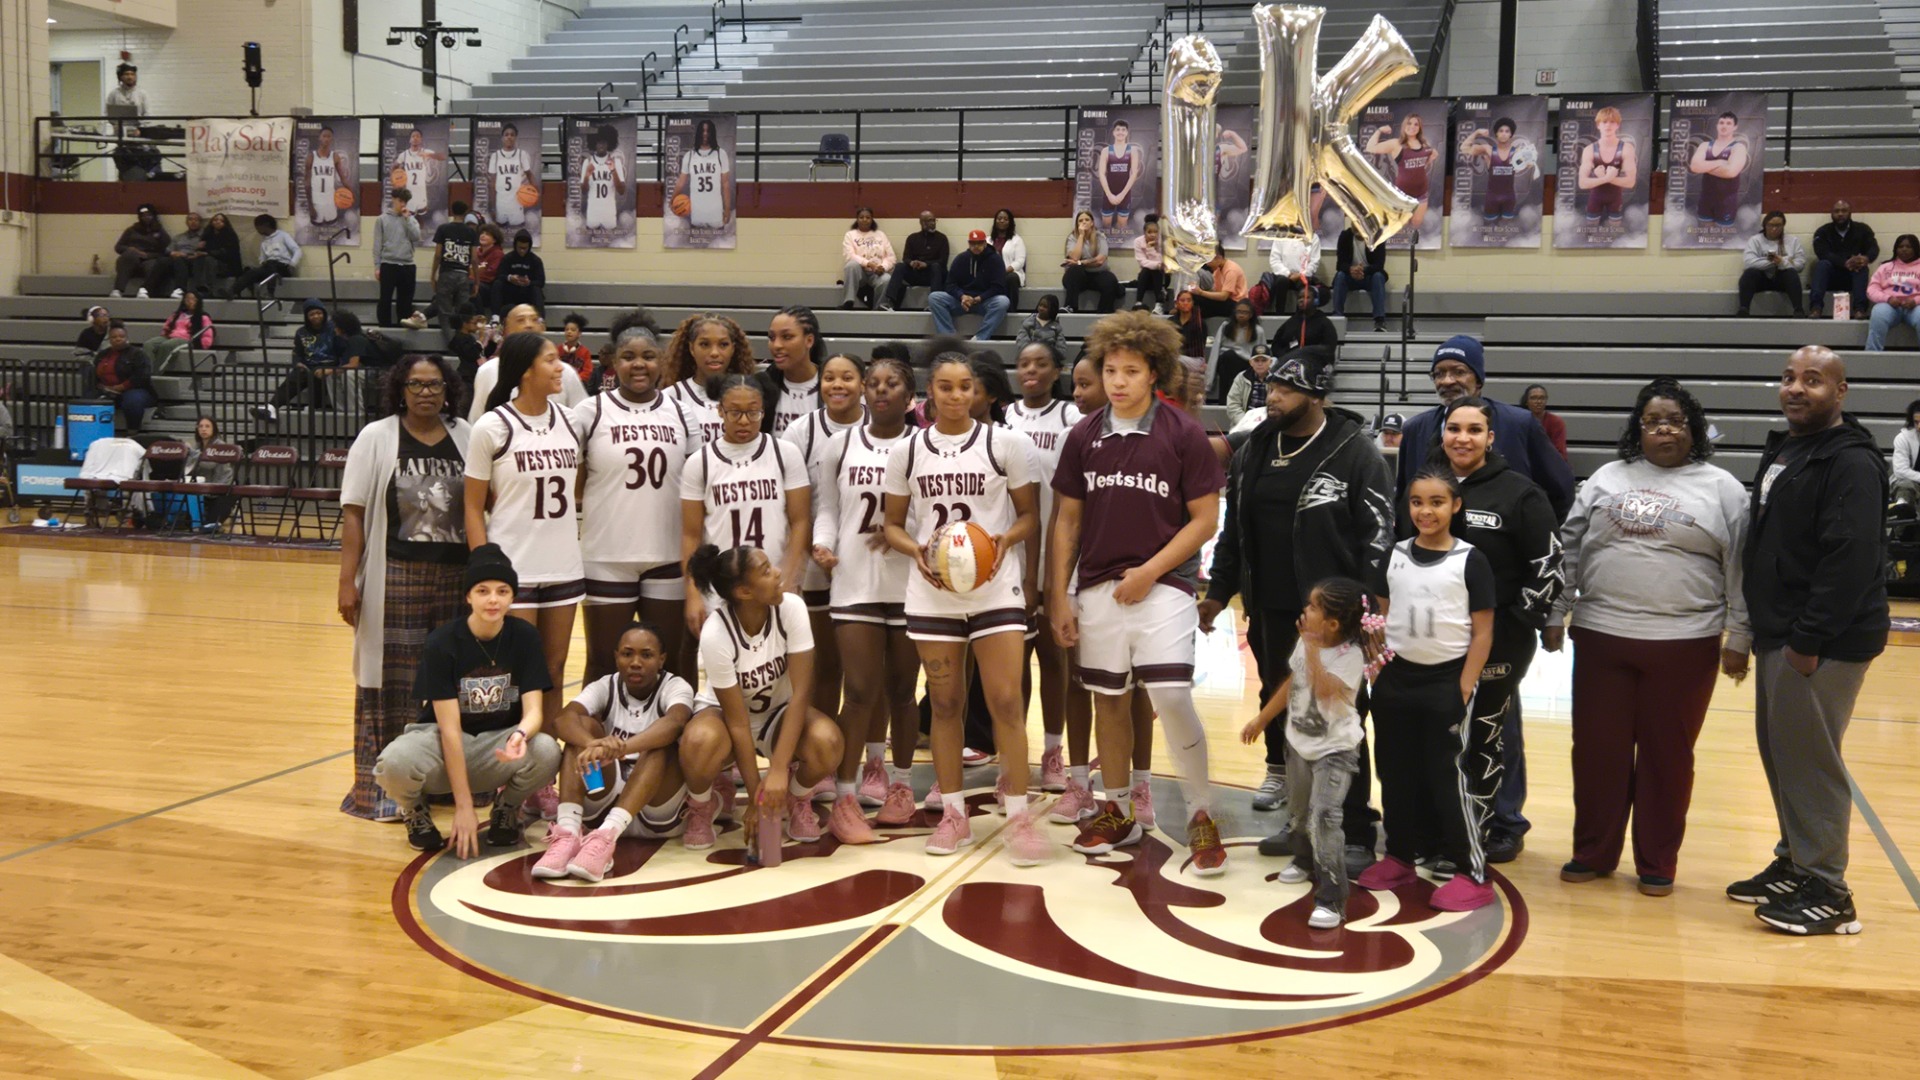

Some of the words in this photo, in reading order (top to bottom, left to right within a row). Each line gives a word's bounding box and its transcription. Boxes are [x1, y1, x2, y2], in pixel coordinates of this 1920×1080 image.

[1540, 71, 1555, 82] EXIT
[1366, 106, 1389, 114] ALEXIS
[1465, 102, 1488, 110] ISAIAH
[1566, 101, 1594, 109] JACOBY
[1675, 99, 1707, 107] JARRETT
[1083, 110, 1107, 118] DOMINIC
[1078, 128, 1095, 169] 2026
[1458, 119, 1477, 163] 226
[1559, 119, 1580, 164] 2026
[1670, 118, 1691, 162] 2026
[475, 137, 490, 174] 2026
[568, 136, 583, 174] 2026
[665, 135, 681, 173] 2026
[412, 172, 418, 185] 2
[498, 163, 520, 175] RAMS
[693, 163, 716, 175] RAMS
[320, 178, 326, 193] 1
[504, 176, 512, 192] 5
[596, 183, 608, 199] 10
[697, 176, 713, 192] 35
[610, 424, 678, 446] WESTSIDE
[1027, 431, 1059, 451] SIDE
[206, 447, 236, 458] Westside
[258, 450, 292, 459] Westside
[514, 448, 578, 473] WESTSIDE
[625, 446, 668, 490] 30
[849, 466, 885, 487] WEST
[21, 475, 65, 486] POWER
[916, 472, 986, 499] WESTSIDE
[1083, 470, 1170, 498] Westside
[533, 475, 568, 520] 13
[712, 478, 778, 507] WESTSIDE
[730, 506, 765, 550] 14
[1466, 511, 1497, 527] OCKSTAR
[1408, 604, 1436, 639] 11
[1482, 664, 1506, 677] KSTAR
[749, 685, 773, 714] 5
